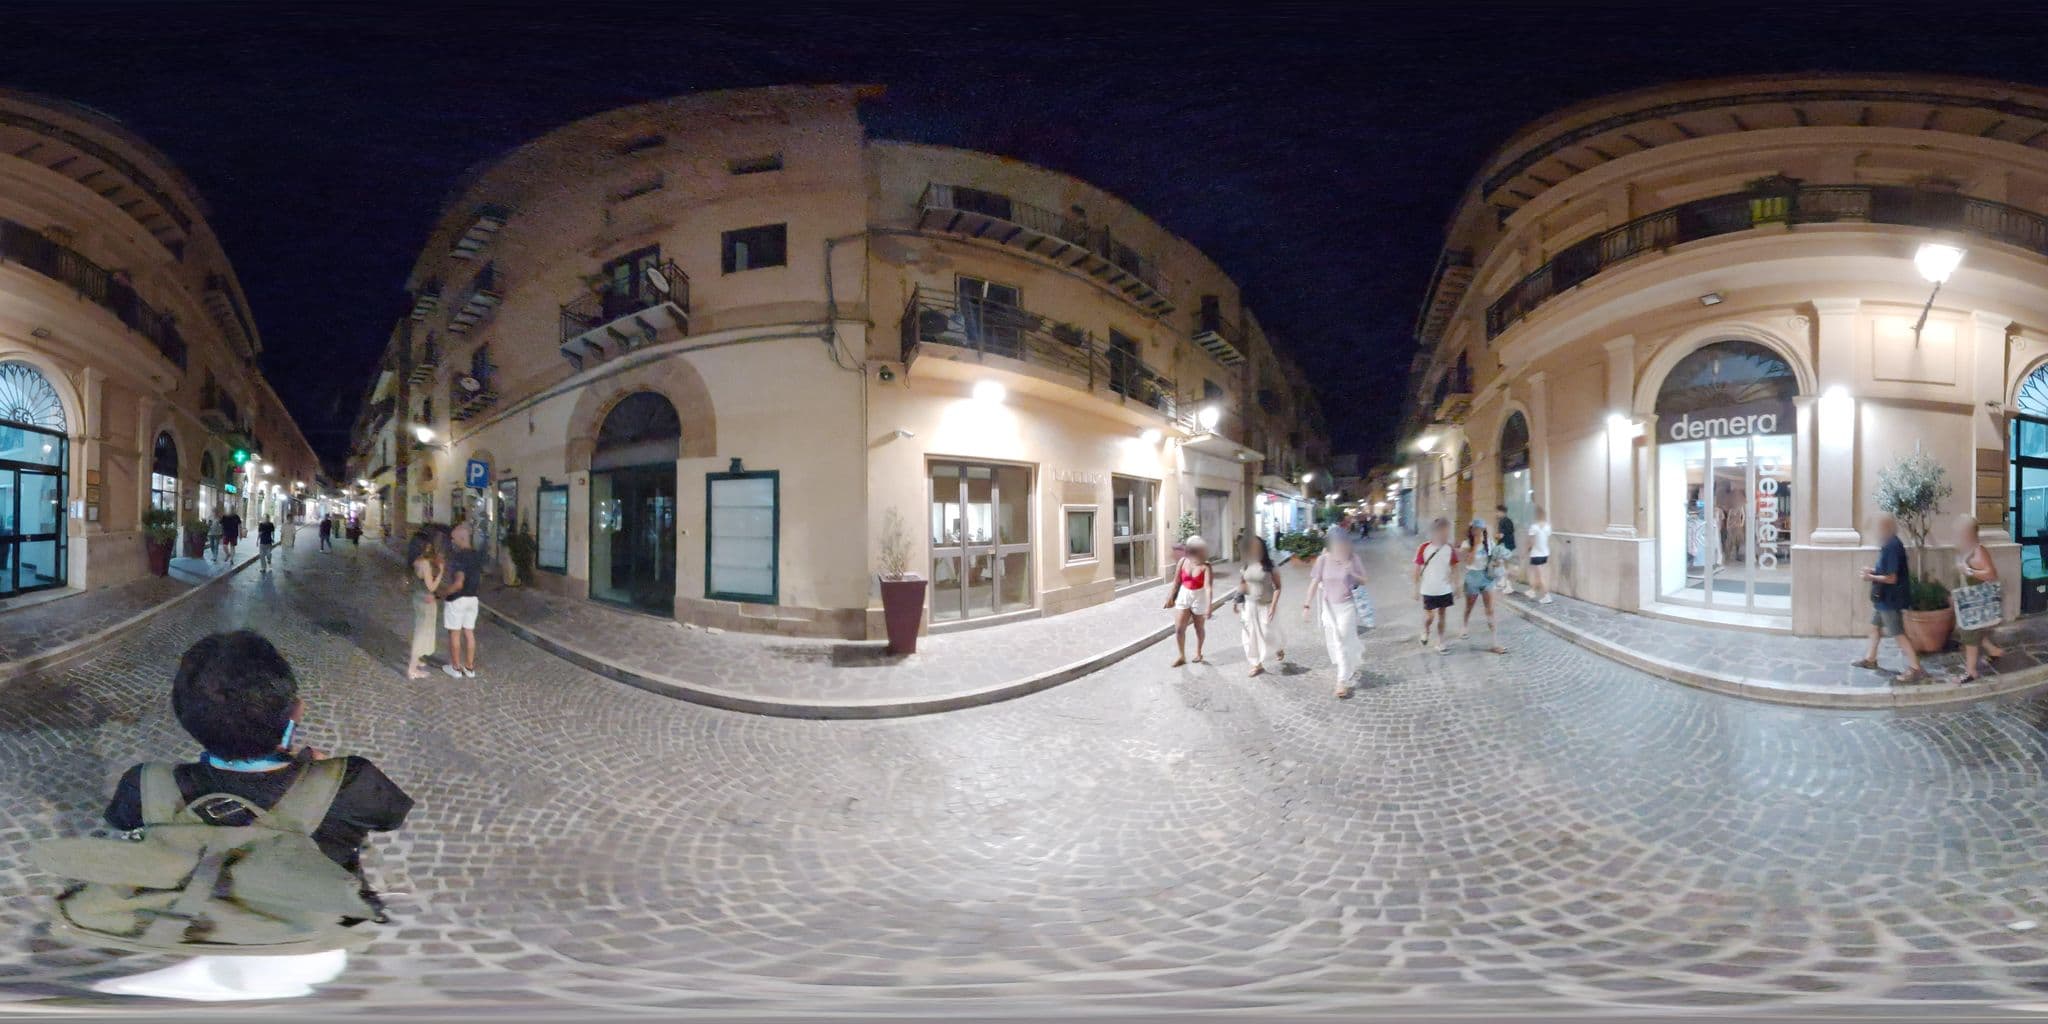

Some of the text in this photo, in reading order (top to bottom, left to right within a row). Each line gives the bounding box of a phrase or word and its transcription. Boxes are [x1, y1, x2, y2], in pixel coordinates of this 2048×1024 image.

[1670, 413, 1777, 441] demera
[470, 463, 485, 484] P
[1759, 459, 1781, 570] demera
